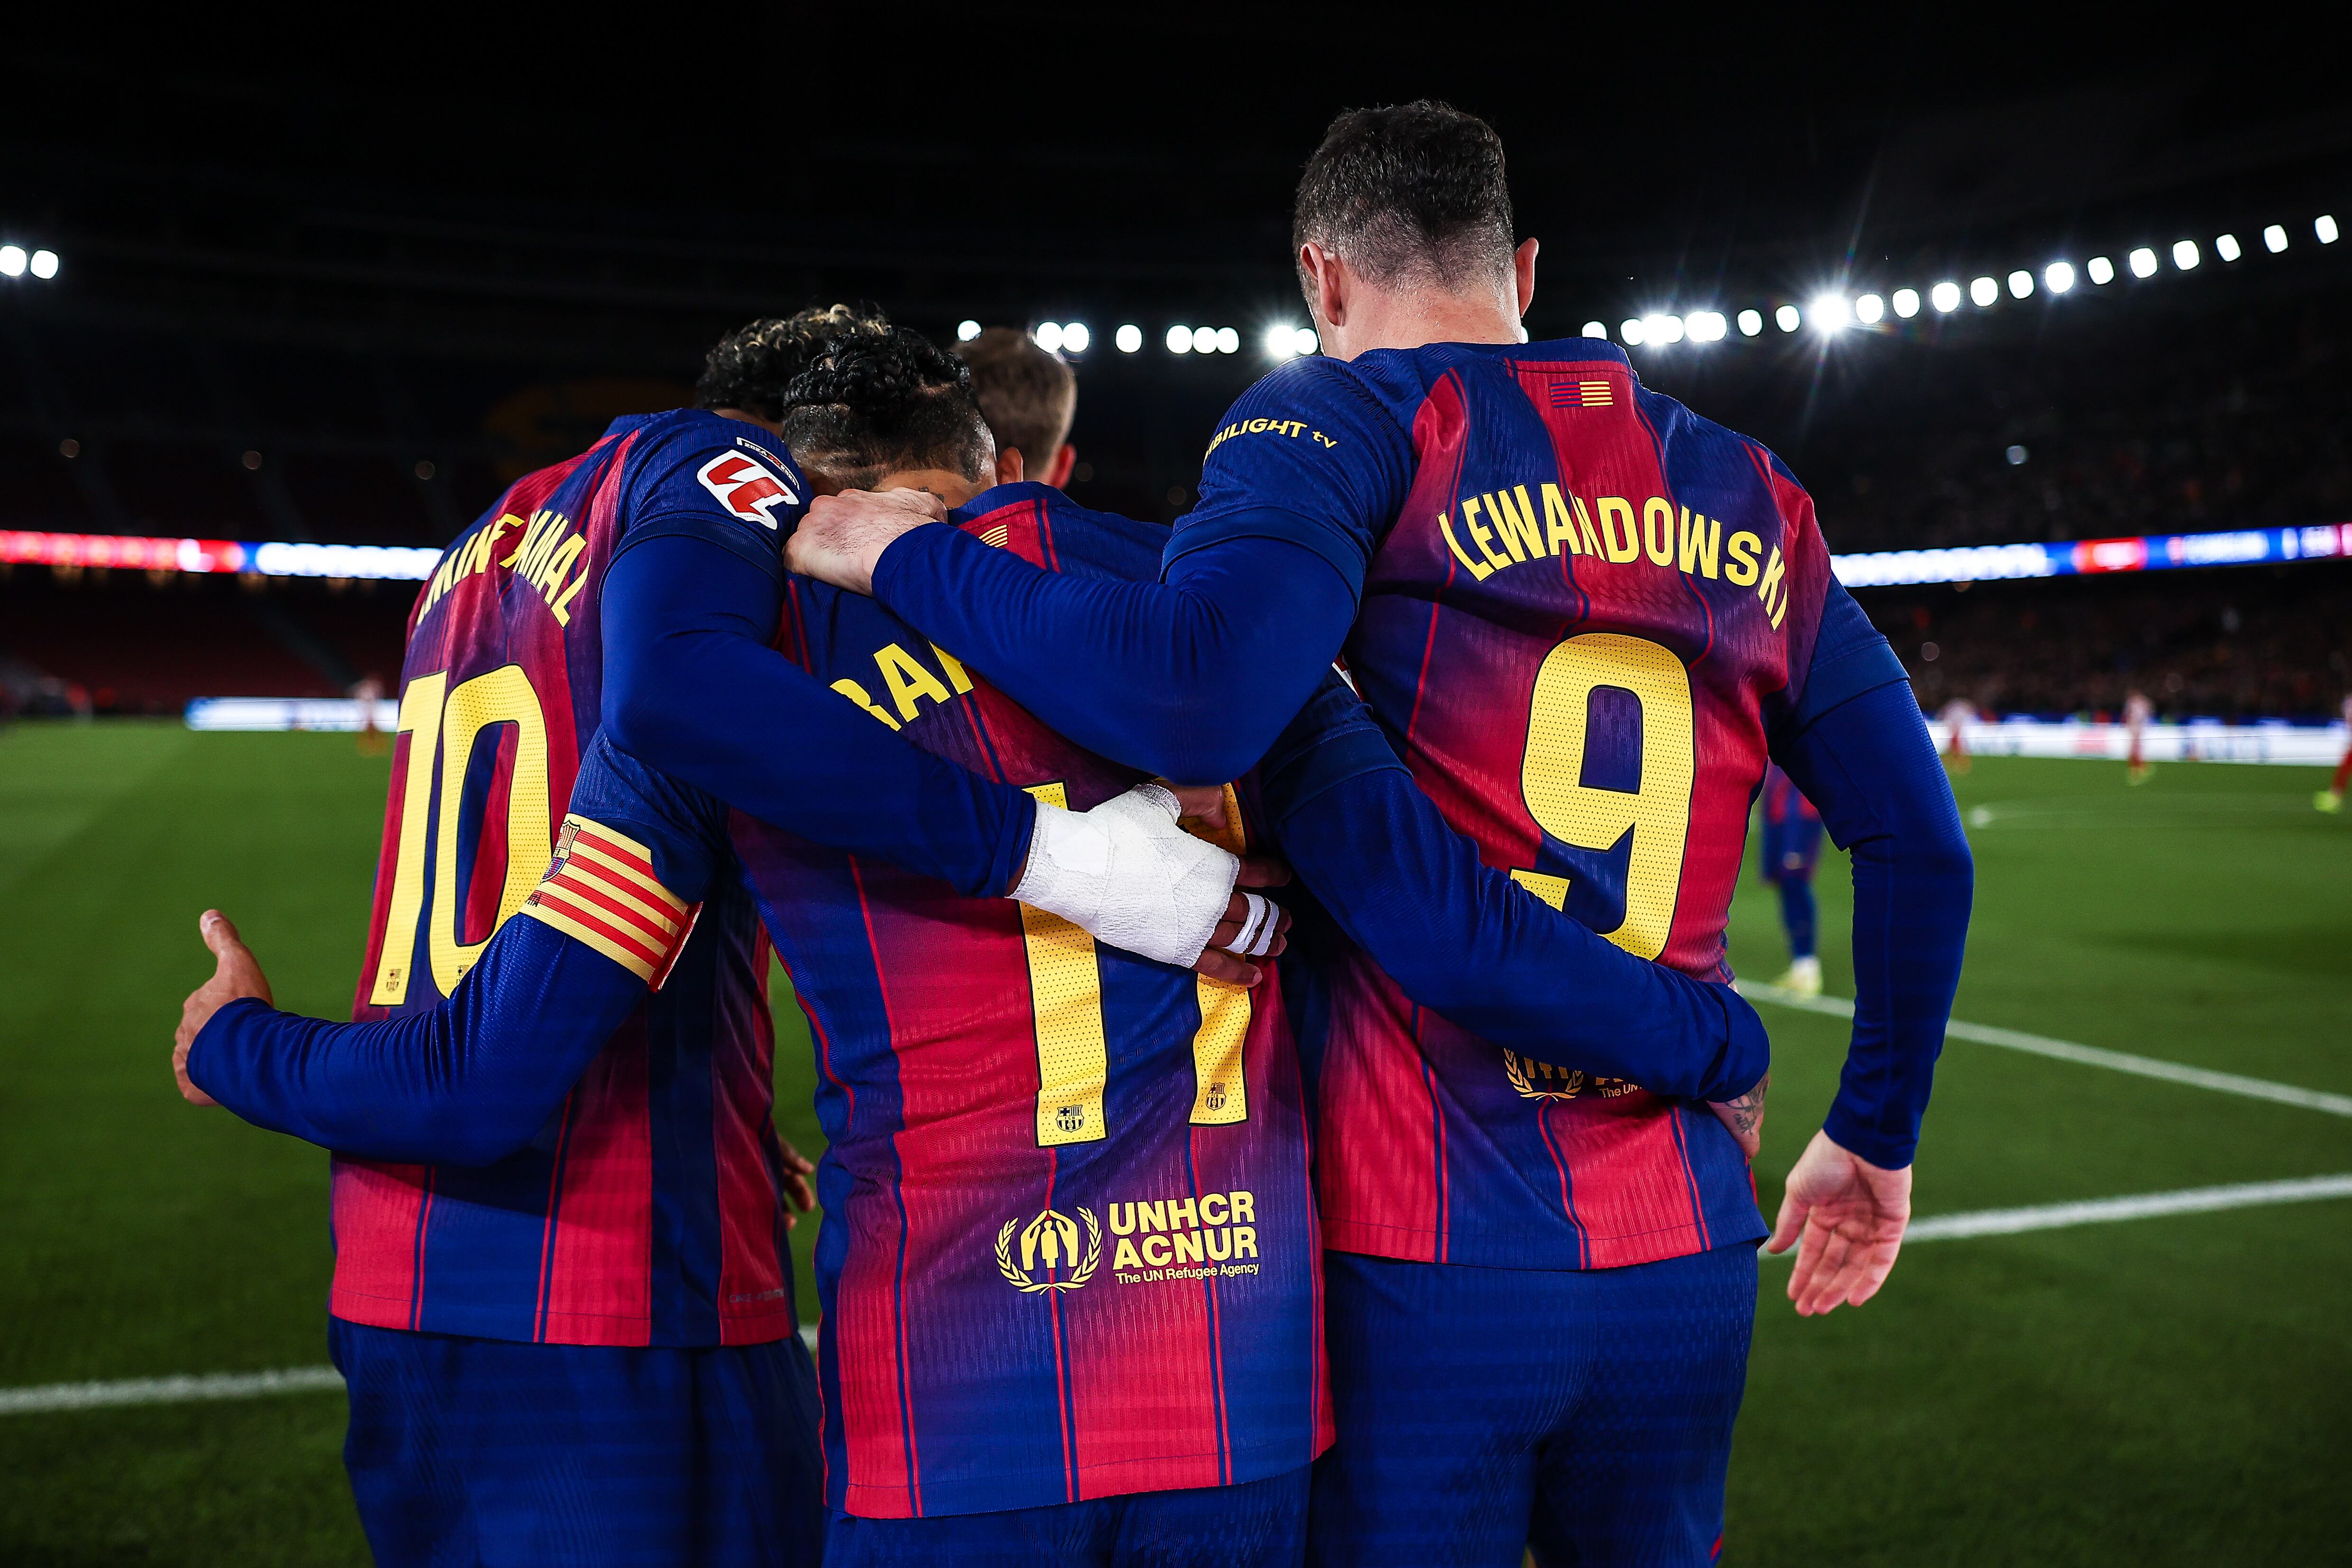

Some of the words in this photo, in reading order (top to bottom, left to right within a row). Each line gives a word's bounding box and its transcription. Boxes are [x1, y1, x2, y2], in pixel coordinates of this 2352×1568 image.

[1312, 430, 1338, 449] tv
[1510, 632, 1696, 961] 9
[369, 664, 553, 1005] 10
[1599, 1088, 1621, 1098] The
[1623, 1084, 1638, 1094] UN
[1108, 1190, 1255, 1236] UNHCR
[1112, 1226, 1258, 1270] ACNUR
[1115, 1273, 1141, 1284] The
[1143, 1269, 1164, 1282] UN
[1165, 1266, 1218, 1280] Refugee
[1219, 1263, 1260, 1277] Agency
